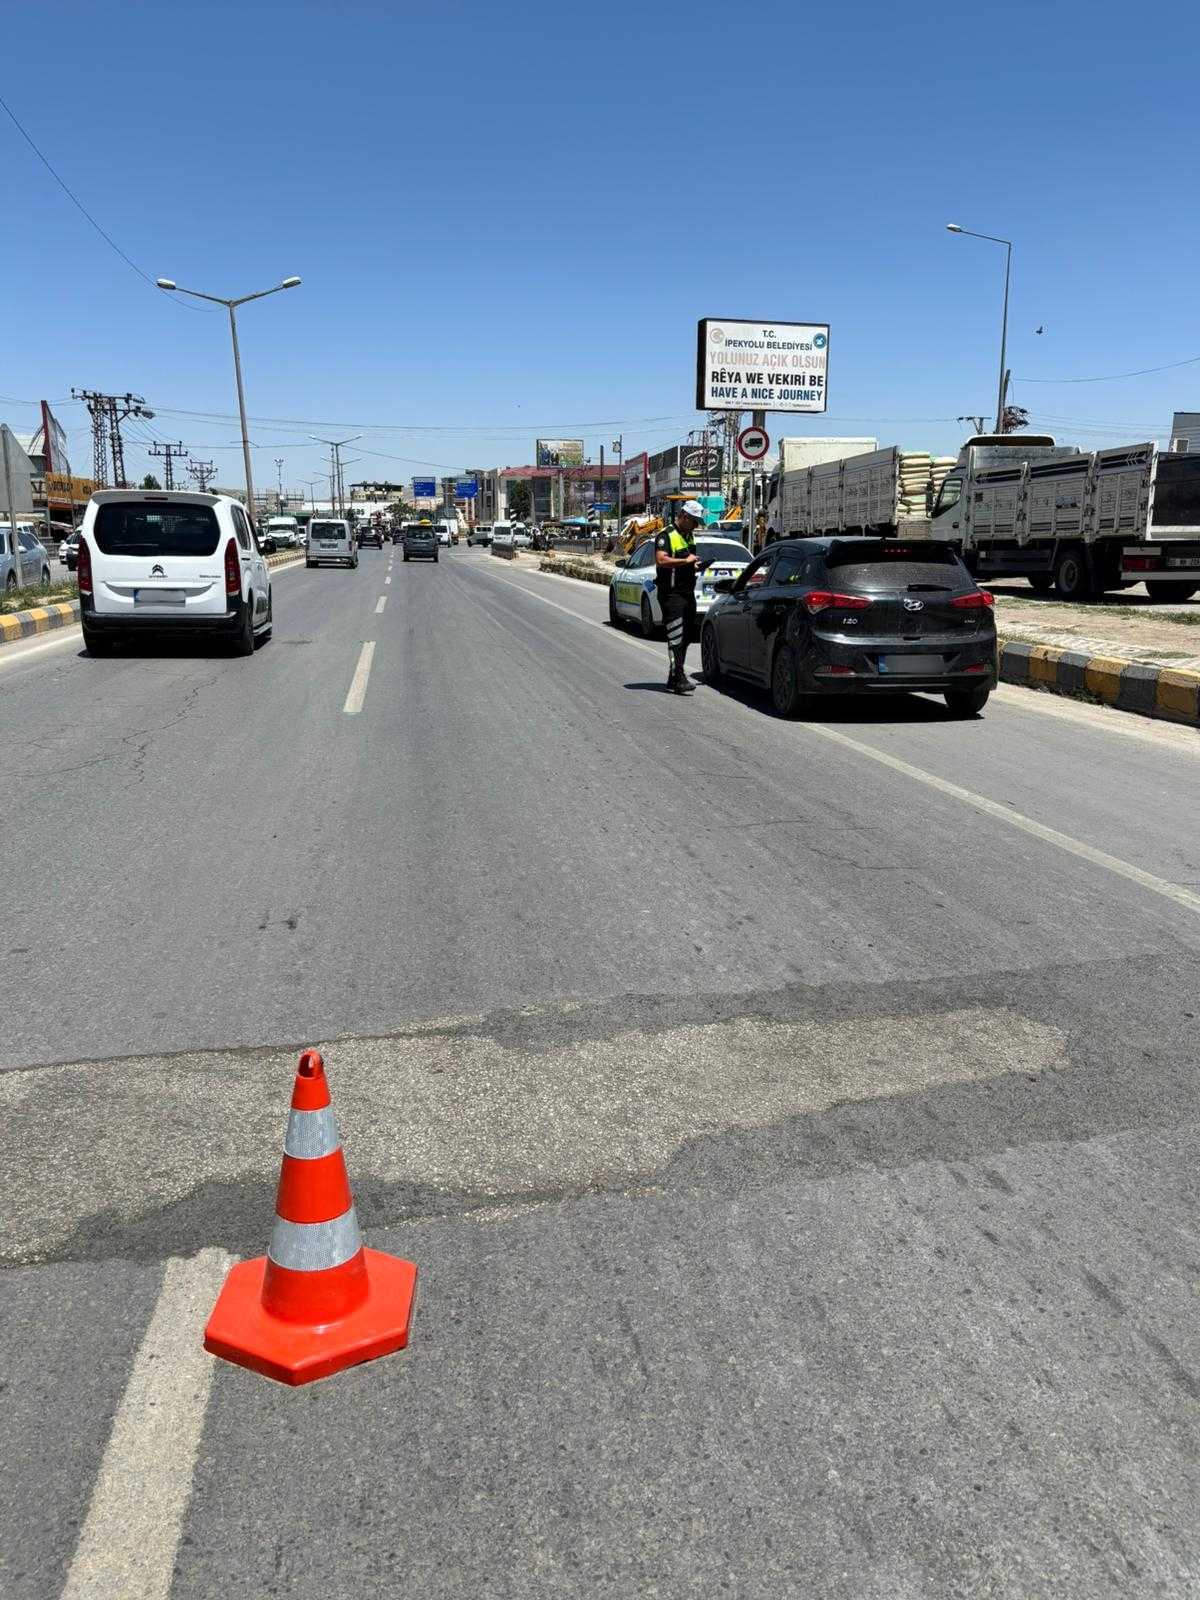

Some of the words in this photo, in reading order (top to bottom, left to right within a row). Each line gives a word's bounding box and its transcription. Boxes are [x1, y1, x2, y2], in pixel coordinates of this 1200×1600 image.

[762, 330, 776, 338] T.C.
[725, 339, 764, 349] İPEKYOLU
[766, 341, 812, 351] BELEDİYESİ
[710, 351, 759, 365] YOLUNUZ
[761, 354, 789, 370] AÇIK
[792, 355, 826, 369] OLSUN
[711, 367, 742, 384] RÊYA
[746, 372, 763, 385] WE
[767, 371, 806, 386] VEKIRÎ
[809, 375, 824, 387] BE
[711, 386, 738, 398] HAVE
[741, 388, 748, 399] A
[751, 388, 774, 400] NICE
[777, 389, 823, 401] JOURNEY
